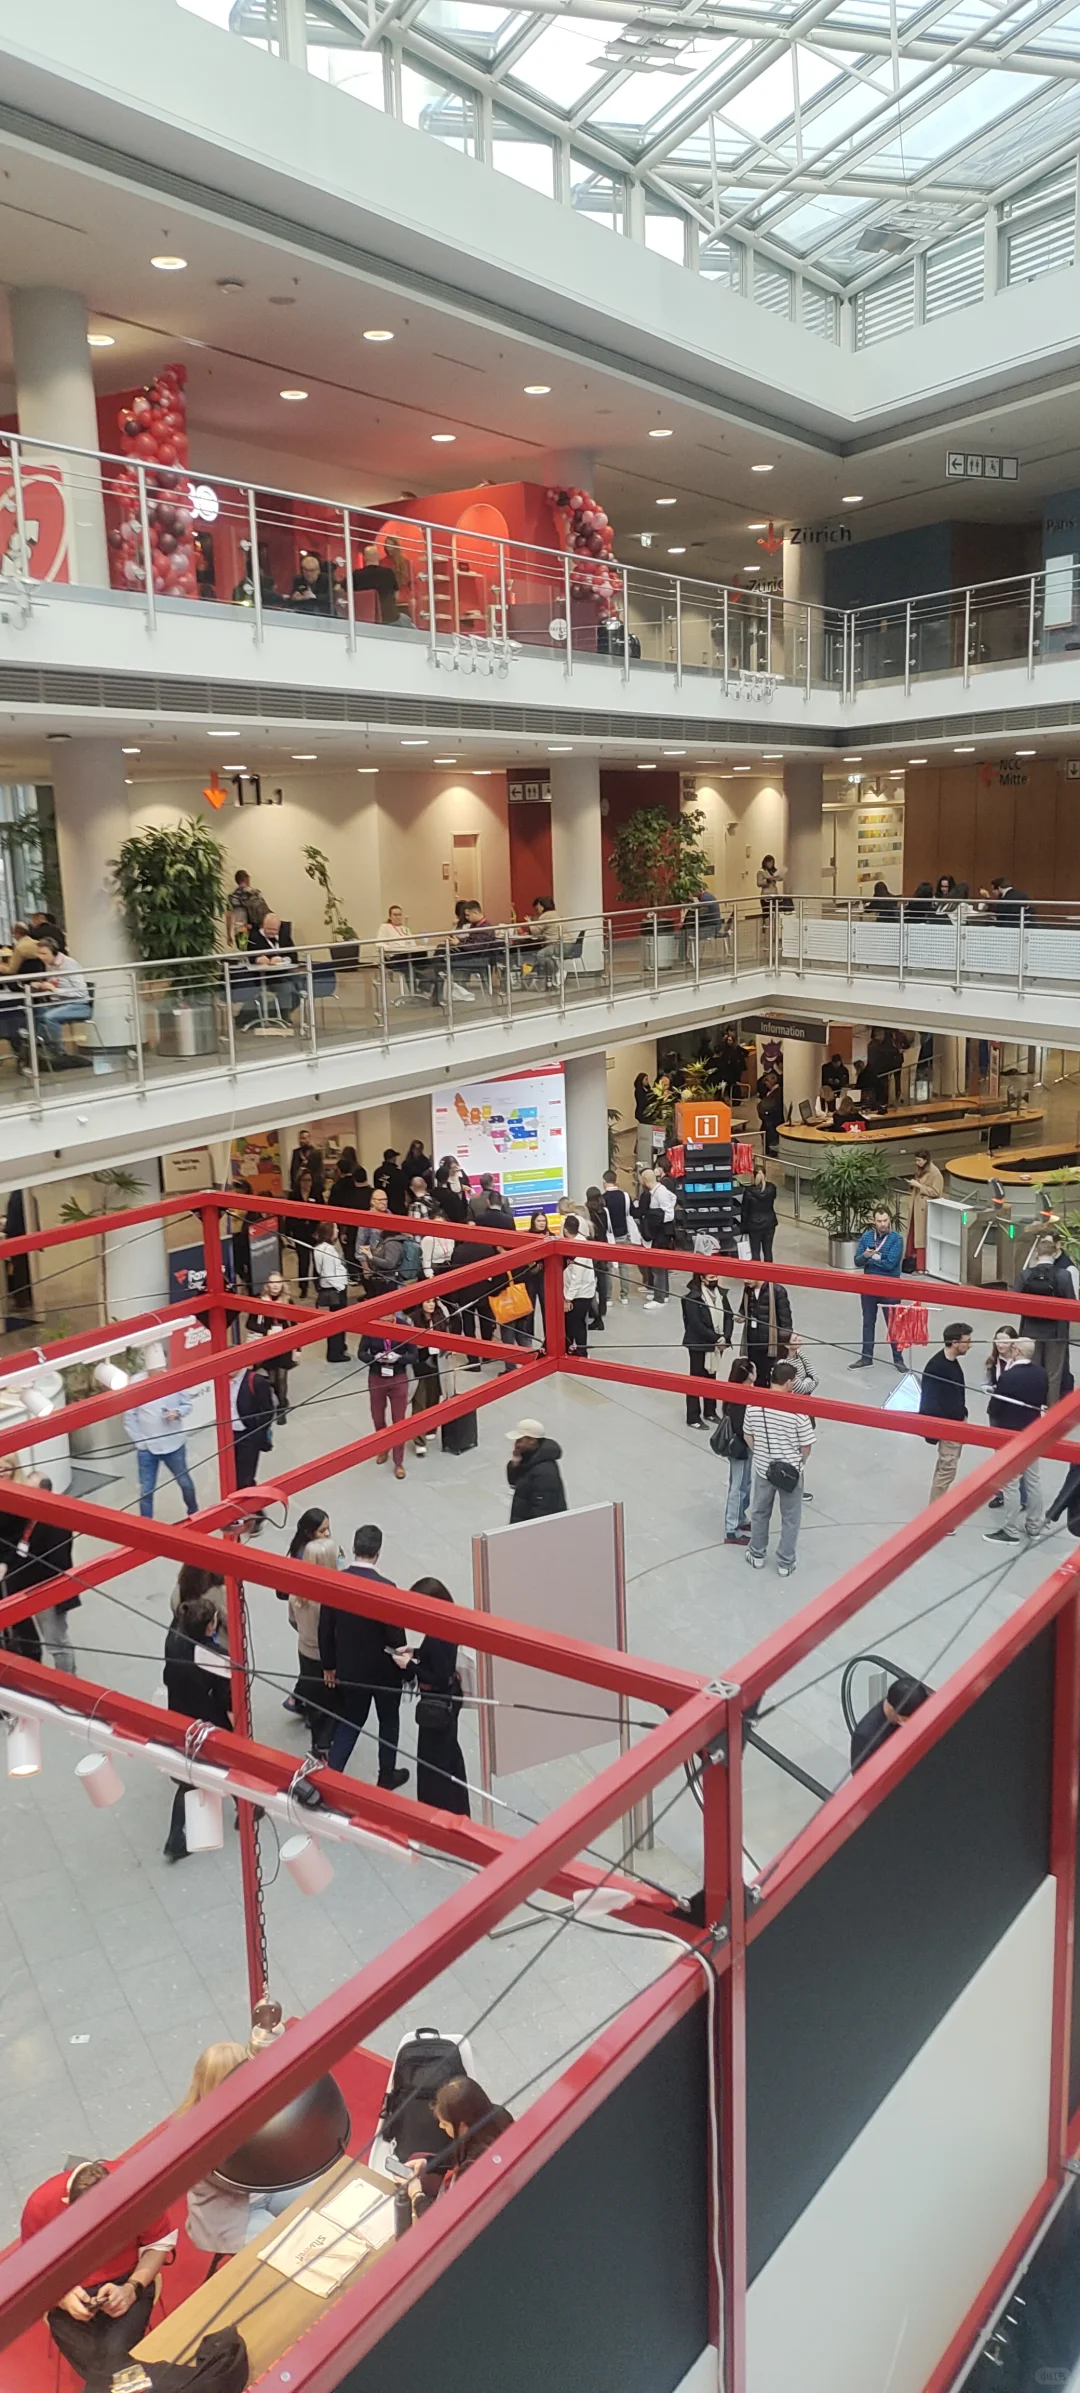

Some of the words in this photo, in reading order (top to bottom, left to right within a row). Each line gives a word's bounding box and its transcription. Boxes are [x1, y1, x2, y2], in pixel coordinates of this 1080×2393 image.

[790, 526, 852, 545] Zürich
[748, 576, 784, 594] Züric
[1000, 758, 1021, 770] NCC
[999, 773, 1029, 786] Mitte
[760, 1021, 806, 1038] Information
